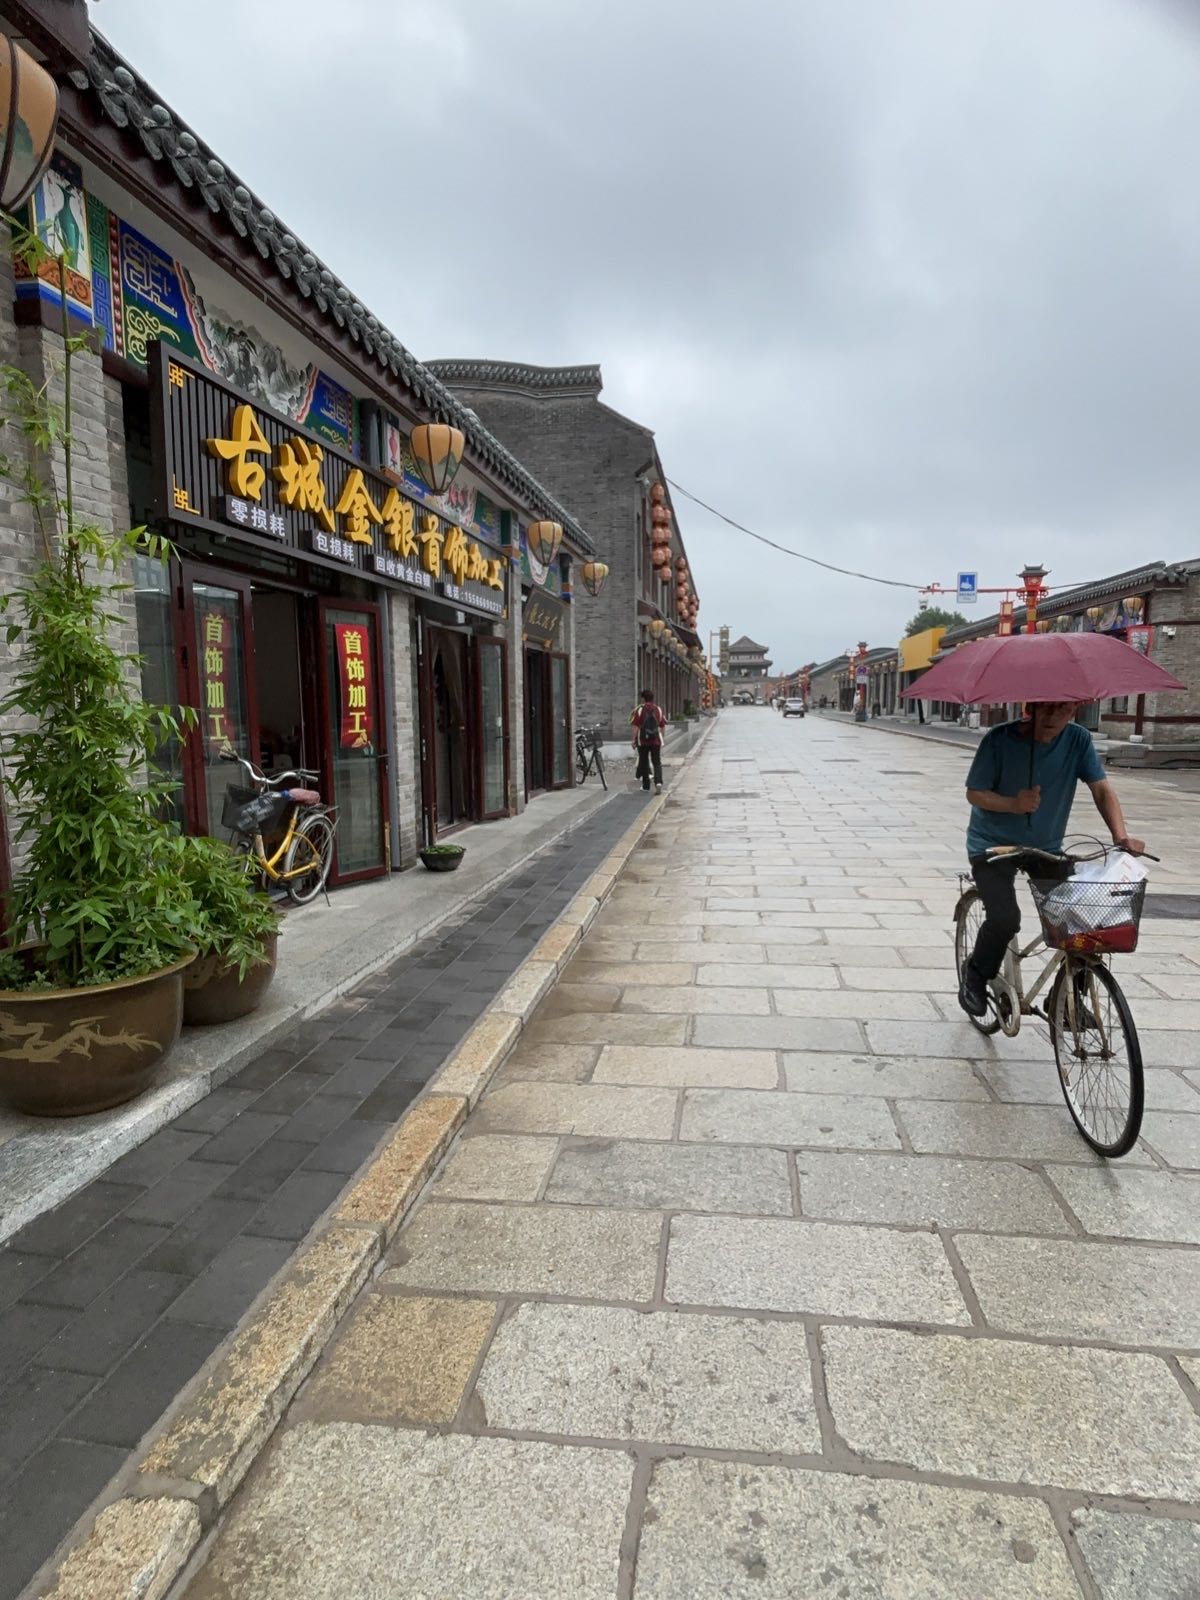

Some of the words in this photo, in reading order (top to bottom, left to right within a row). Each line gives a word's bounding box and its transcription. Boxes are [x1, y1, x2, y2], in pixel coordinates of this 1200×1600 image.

[206, 404, 505, 592] 古城金银首饰加工
[231, 498, 286, 537] 零损耗
[316, 532, 354, 562] 包损耗
[204, 613, 228, 741] 首饰加工
[343, 630, 367, 734] 首饰加工
